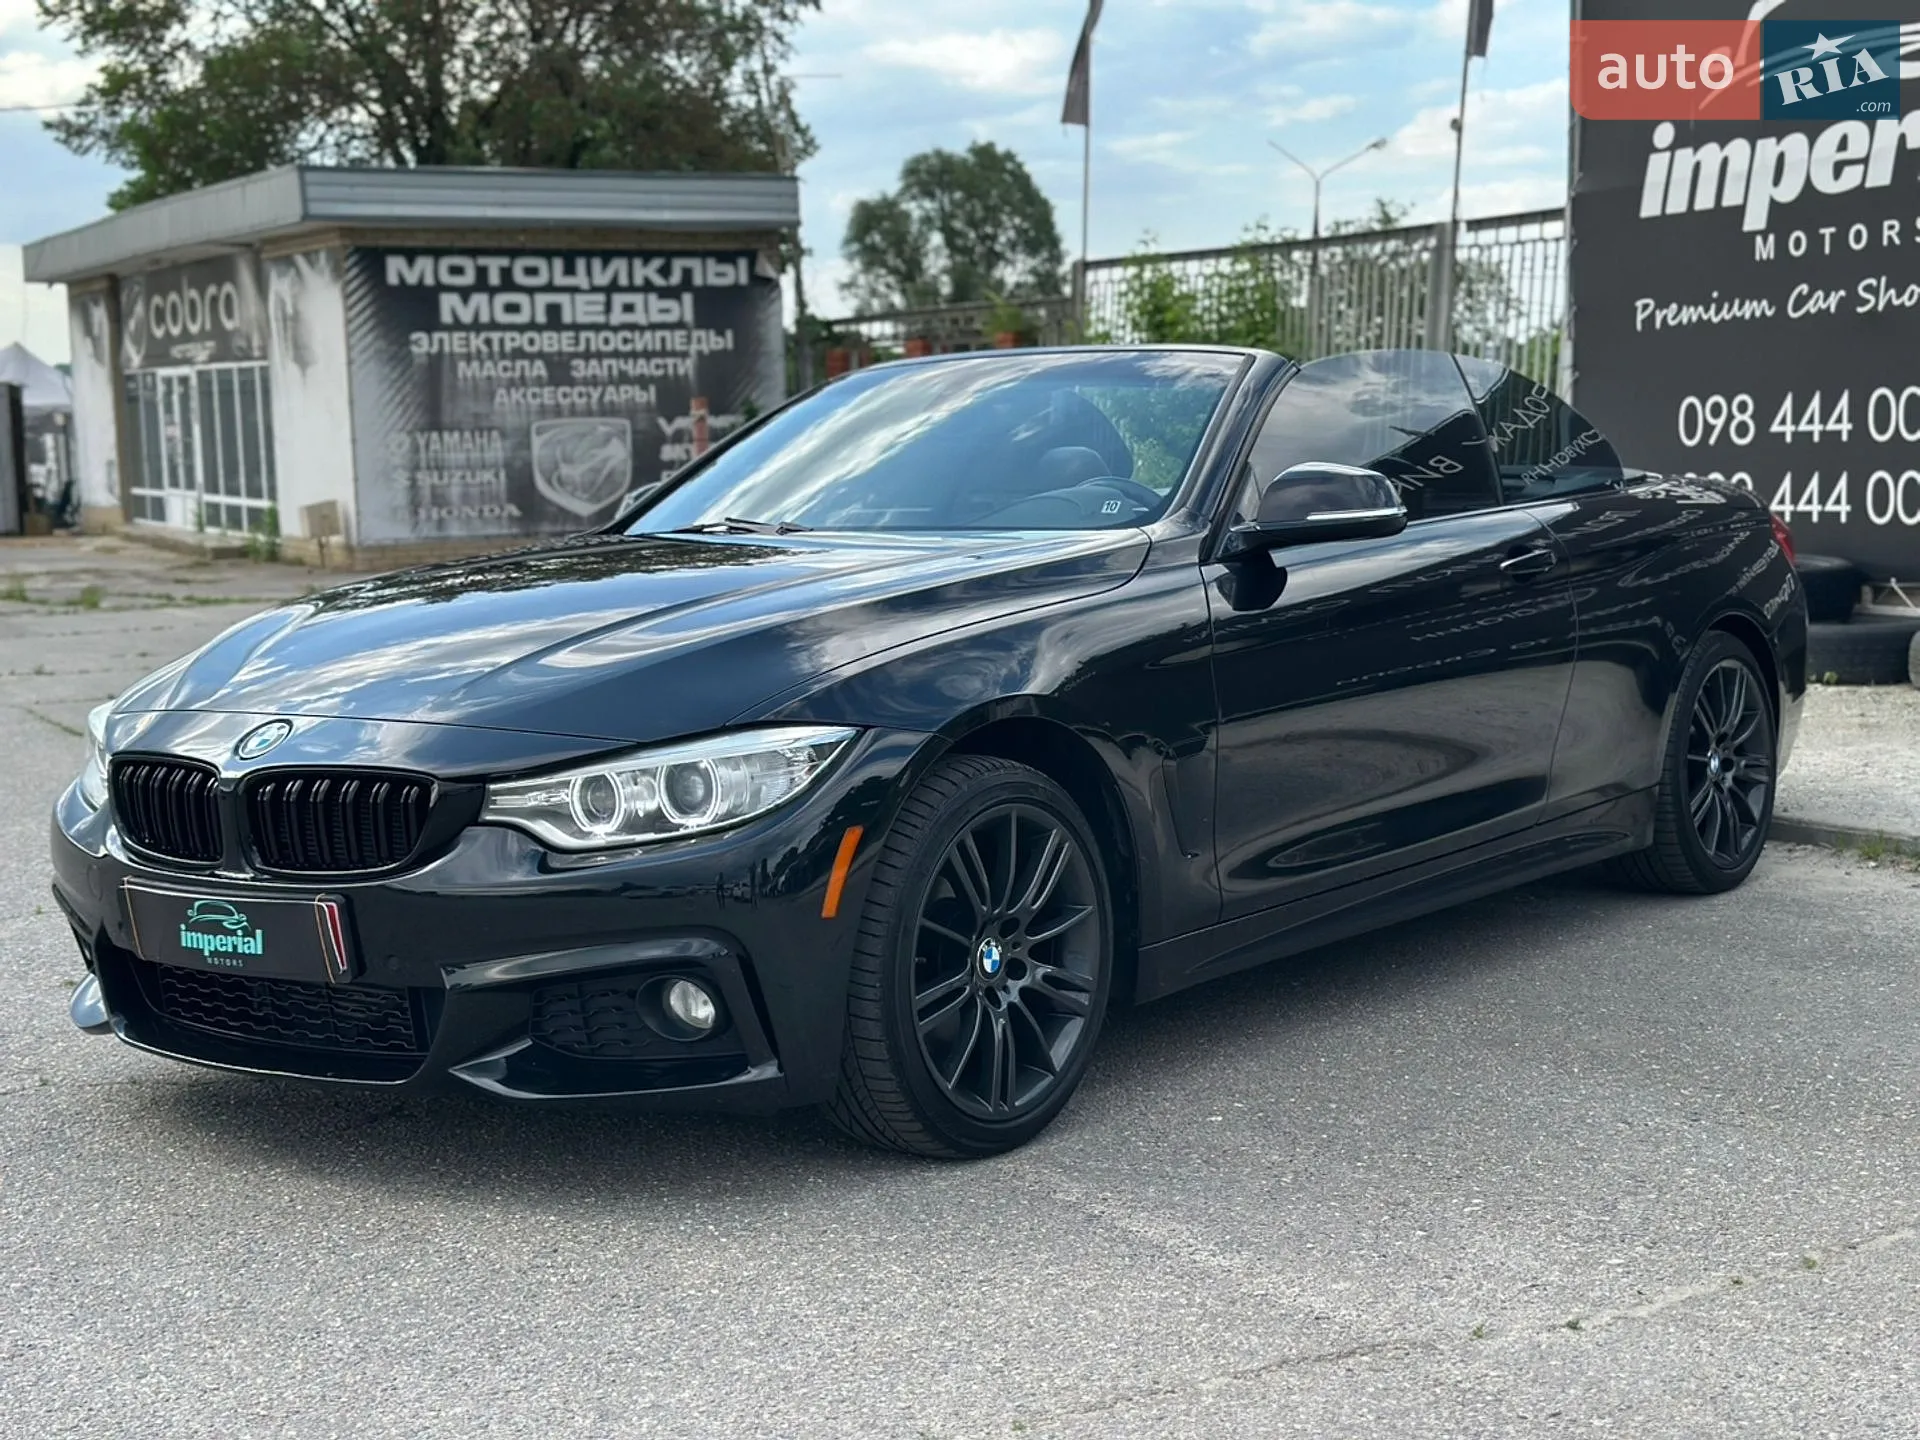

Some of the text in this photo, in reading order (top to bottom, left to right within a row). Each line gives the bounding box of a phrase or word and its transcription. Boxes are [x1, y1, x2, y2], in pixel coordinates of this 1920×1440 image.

[385, 254, 750, 290] МОТОЦИКЛЫ
[149, 275, 241, 339] cobra
[438, 291, 697, 326] МОПЕДЫ
[1634, 290, 1776, 332] Premium
[1787, 282, 1847, 319] Car
[409, 330, 735, 355] ЭЛЕКТРОВЕЛОСИПЕДЫ
[457, 357, 696, 379] МАСЛА ЗАПЧАСТИ
[493, 385, 657, 406] АКСЕССУАРЫ
[1677, 393, 1756, 447] 098
[1769, 389, 1853, 444] 444
[1769, 470, 1852, 523] 444
[180, 923, 263, 956] imperial
